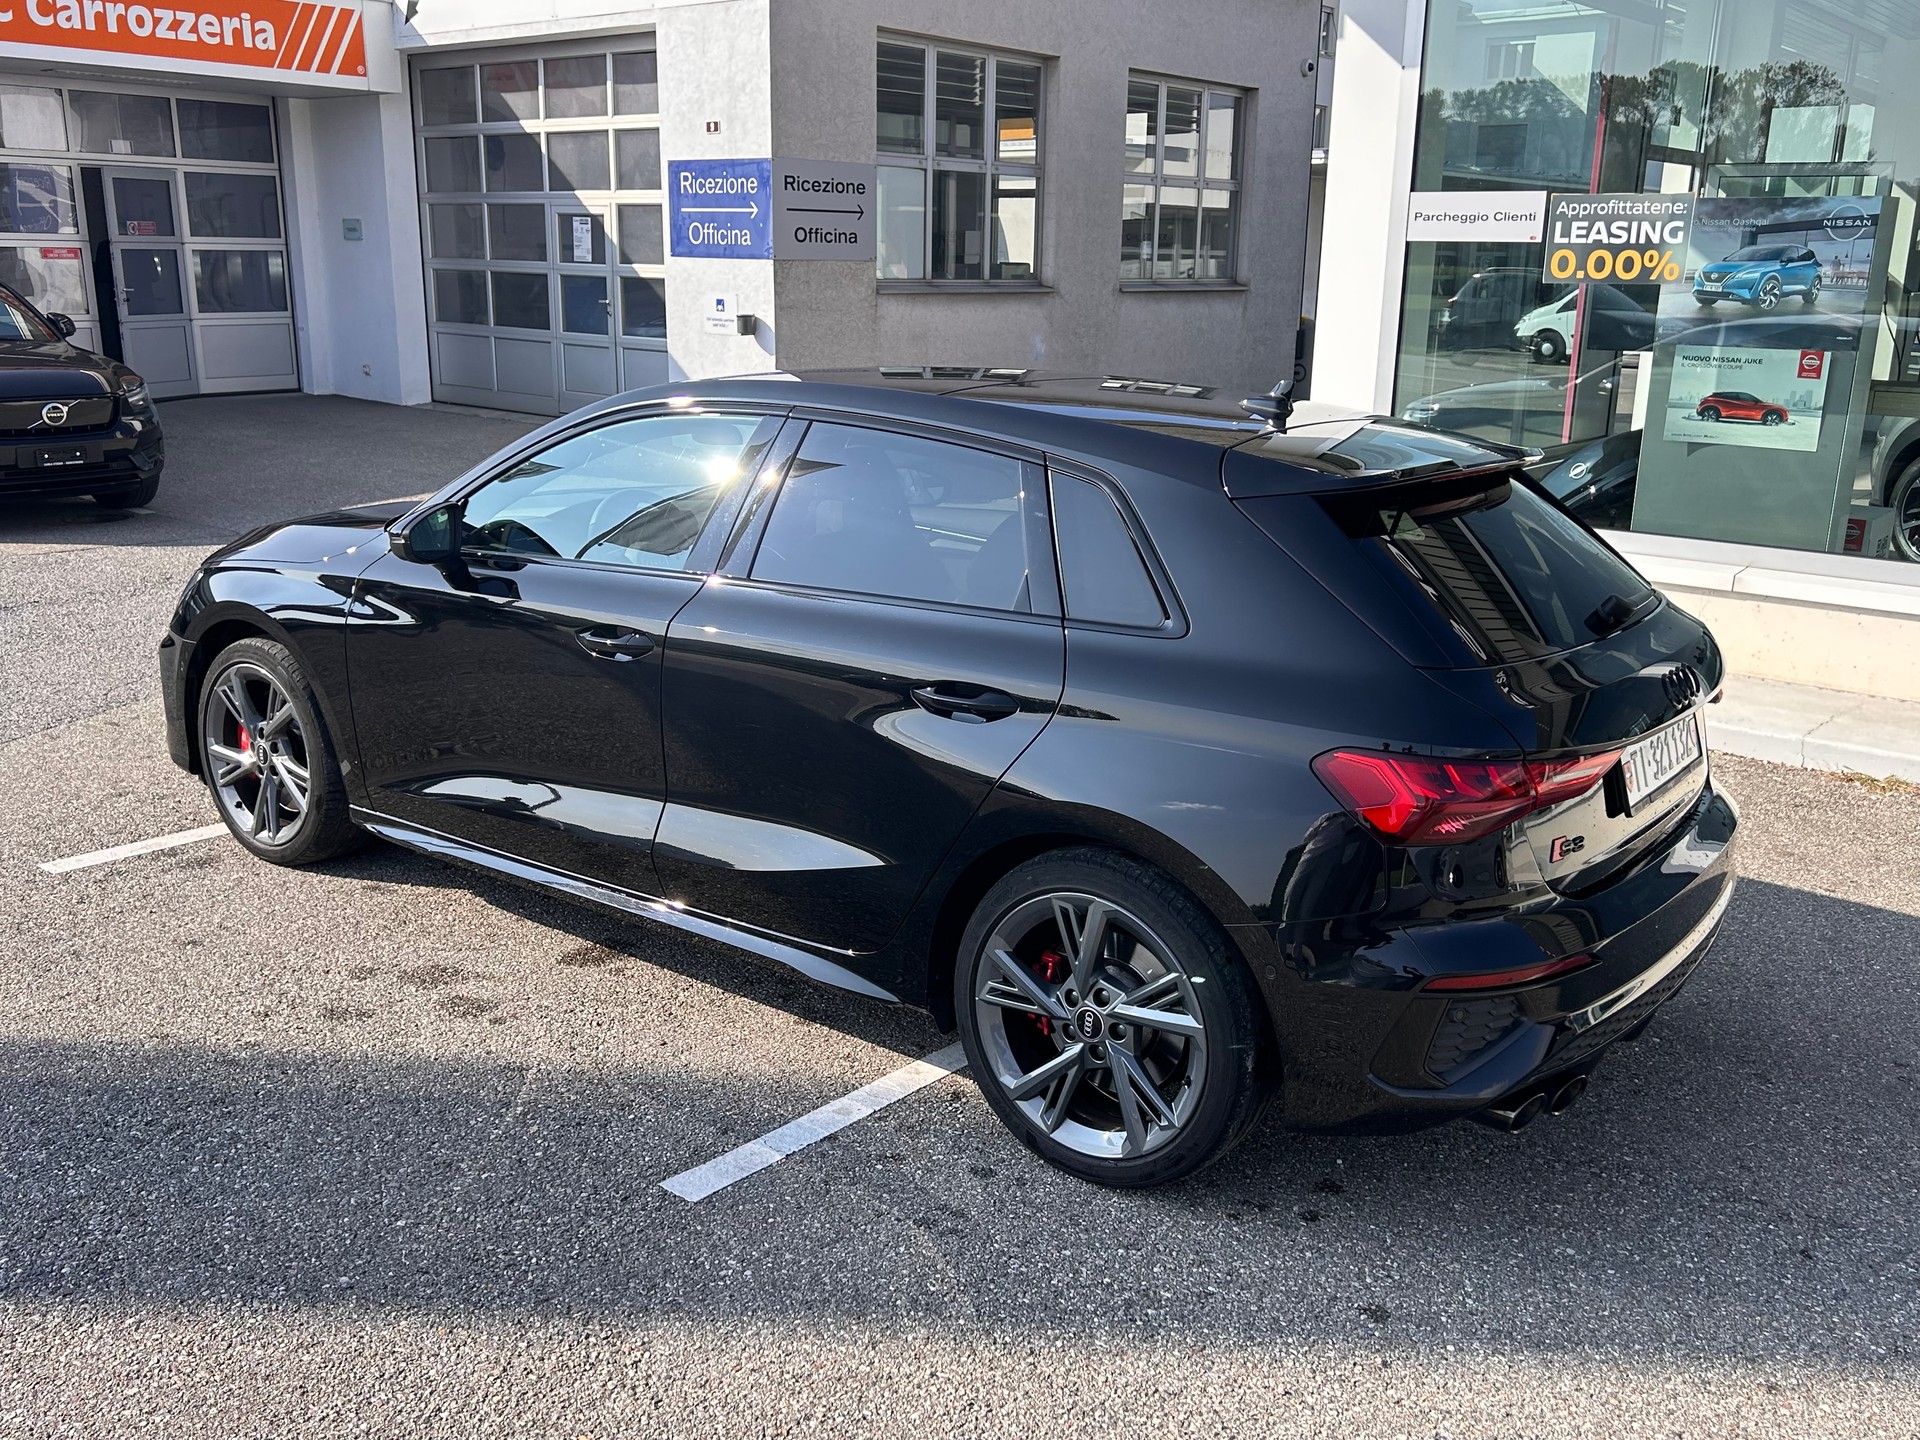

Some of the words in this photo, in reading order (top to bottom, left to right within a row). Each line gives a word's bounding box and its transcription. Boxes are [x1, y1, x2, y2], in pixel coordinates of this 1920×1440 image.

[26, 0, 277, 51] Carrozzeria
[680, 171, 758, 194] Ricezione
[784, 175, 866, 195] Ricezione
[1414, 211, 1489, 224] Parcheggio
[1493, 211, 1537, 222] Clienti
[1556, 200, 1688, 218] Approfittatene:
[1701, 218, 1731, 226] Nissan
[1732, 217, 1770, 227] Qashqai
[1823, 218, 1872, 227] NISSAN
[688, 222, 751, 245] Officina
[794, 226, 858, 245] Officina
[1553, 220, 1685, 244] LEASING
[1550, 248, 1680, 281] 0.00%
[1712, 356, 1742, 364] NISSAN
[1743, 357, 1764, 365] JUKE
